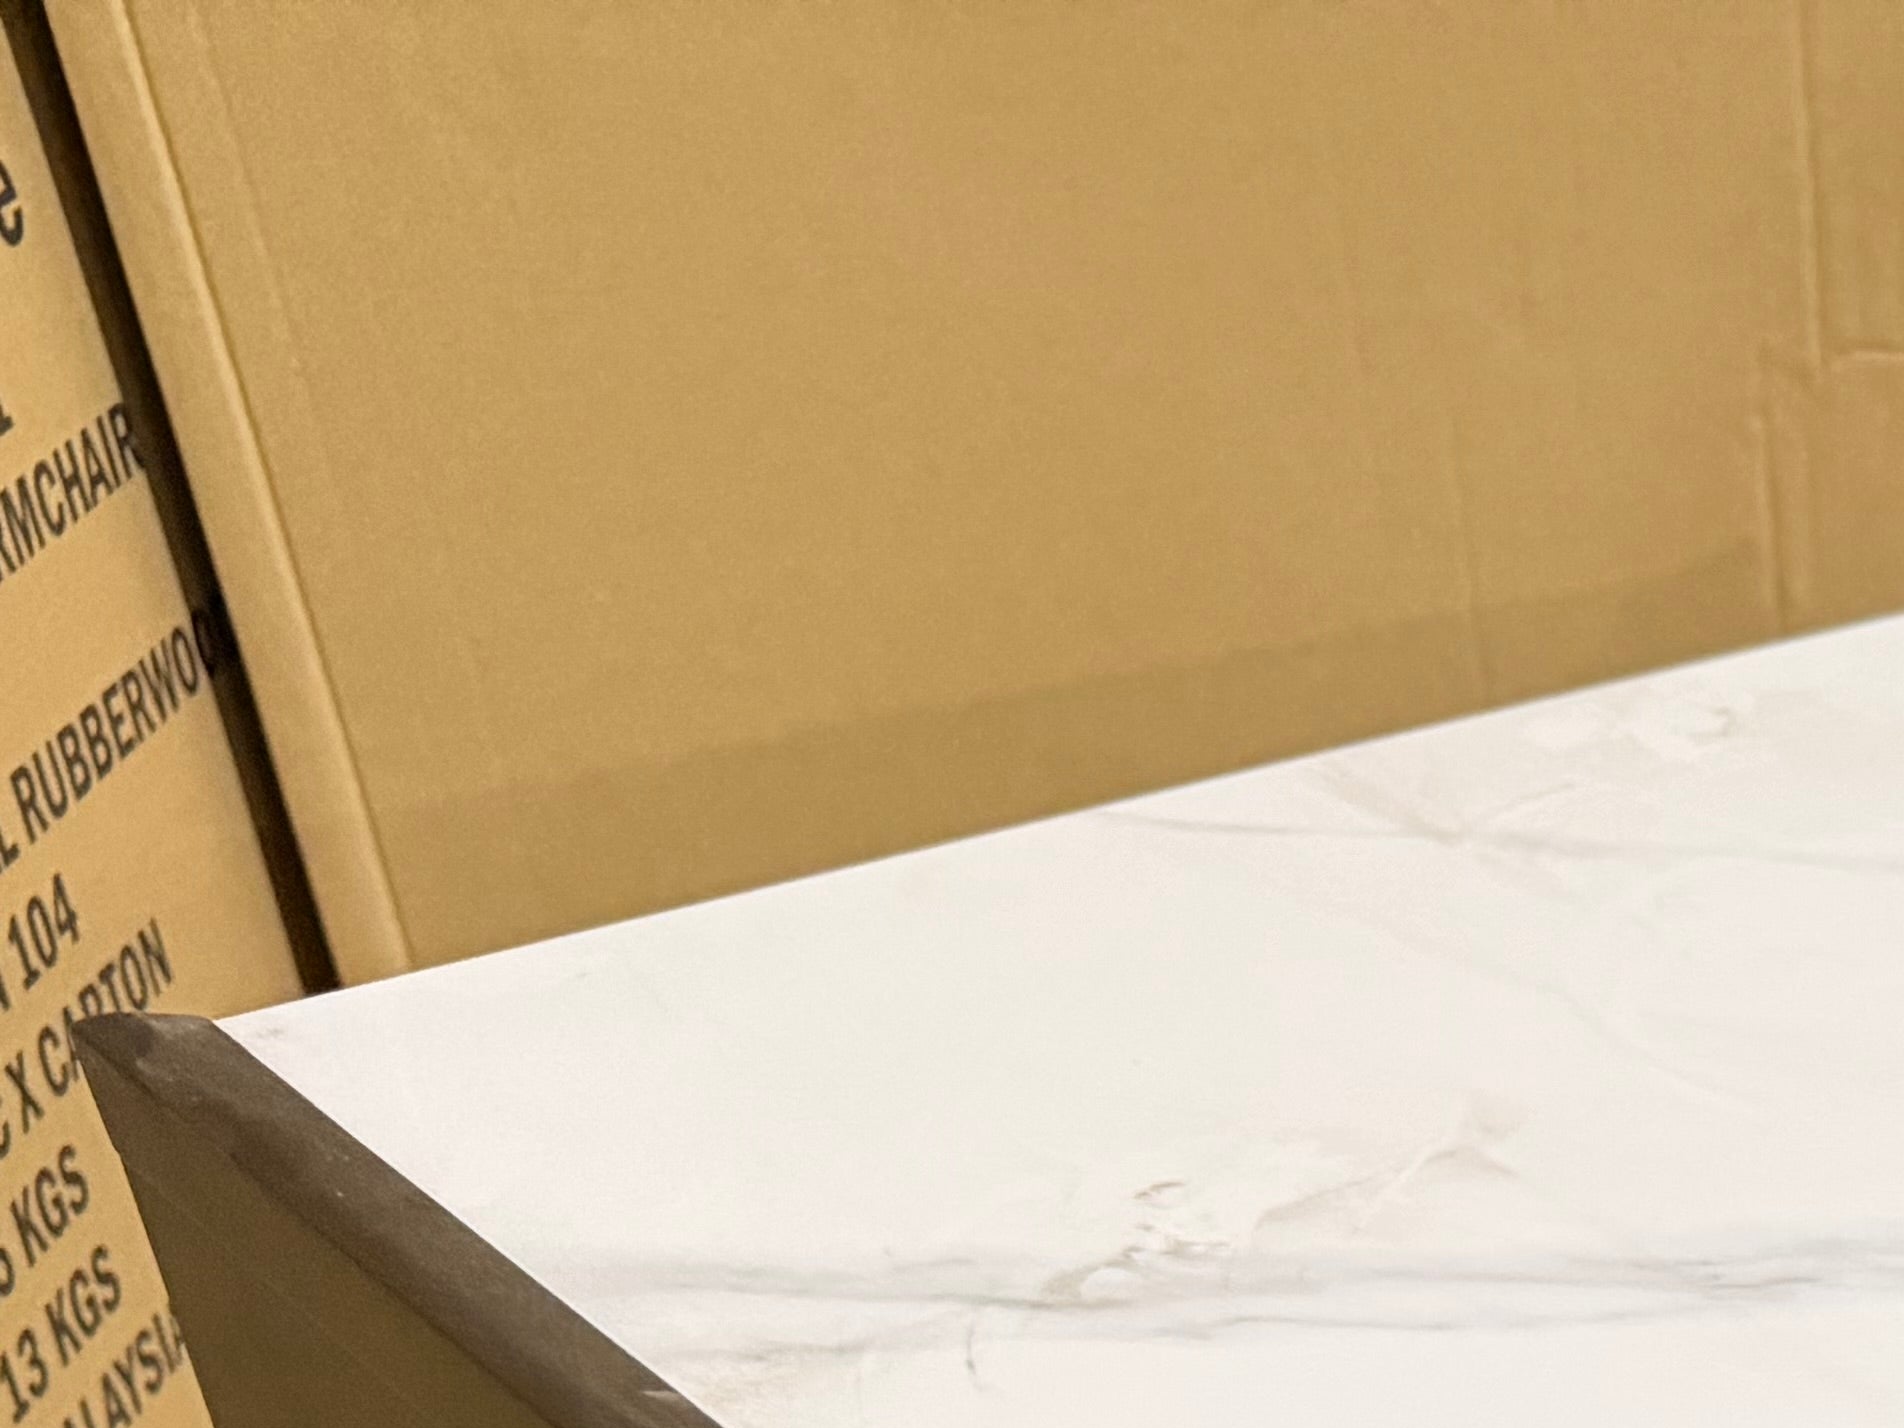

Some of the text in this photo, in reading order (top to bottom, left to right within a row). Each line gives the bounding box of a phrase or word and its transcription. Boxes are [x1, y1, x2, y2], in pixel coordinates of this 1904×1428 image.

[8, 873, 80, 990] 104
[10, 1144, 89, 1267] KGS
[45, 1244, 121, 1367] KGS
